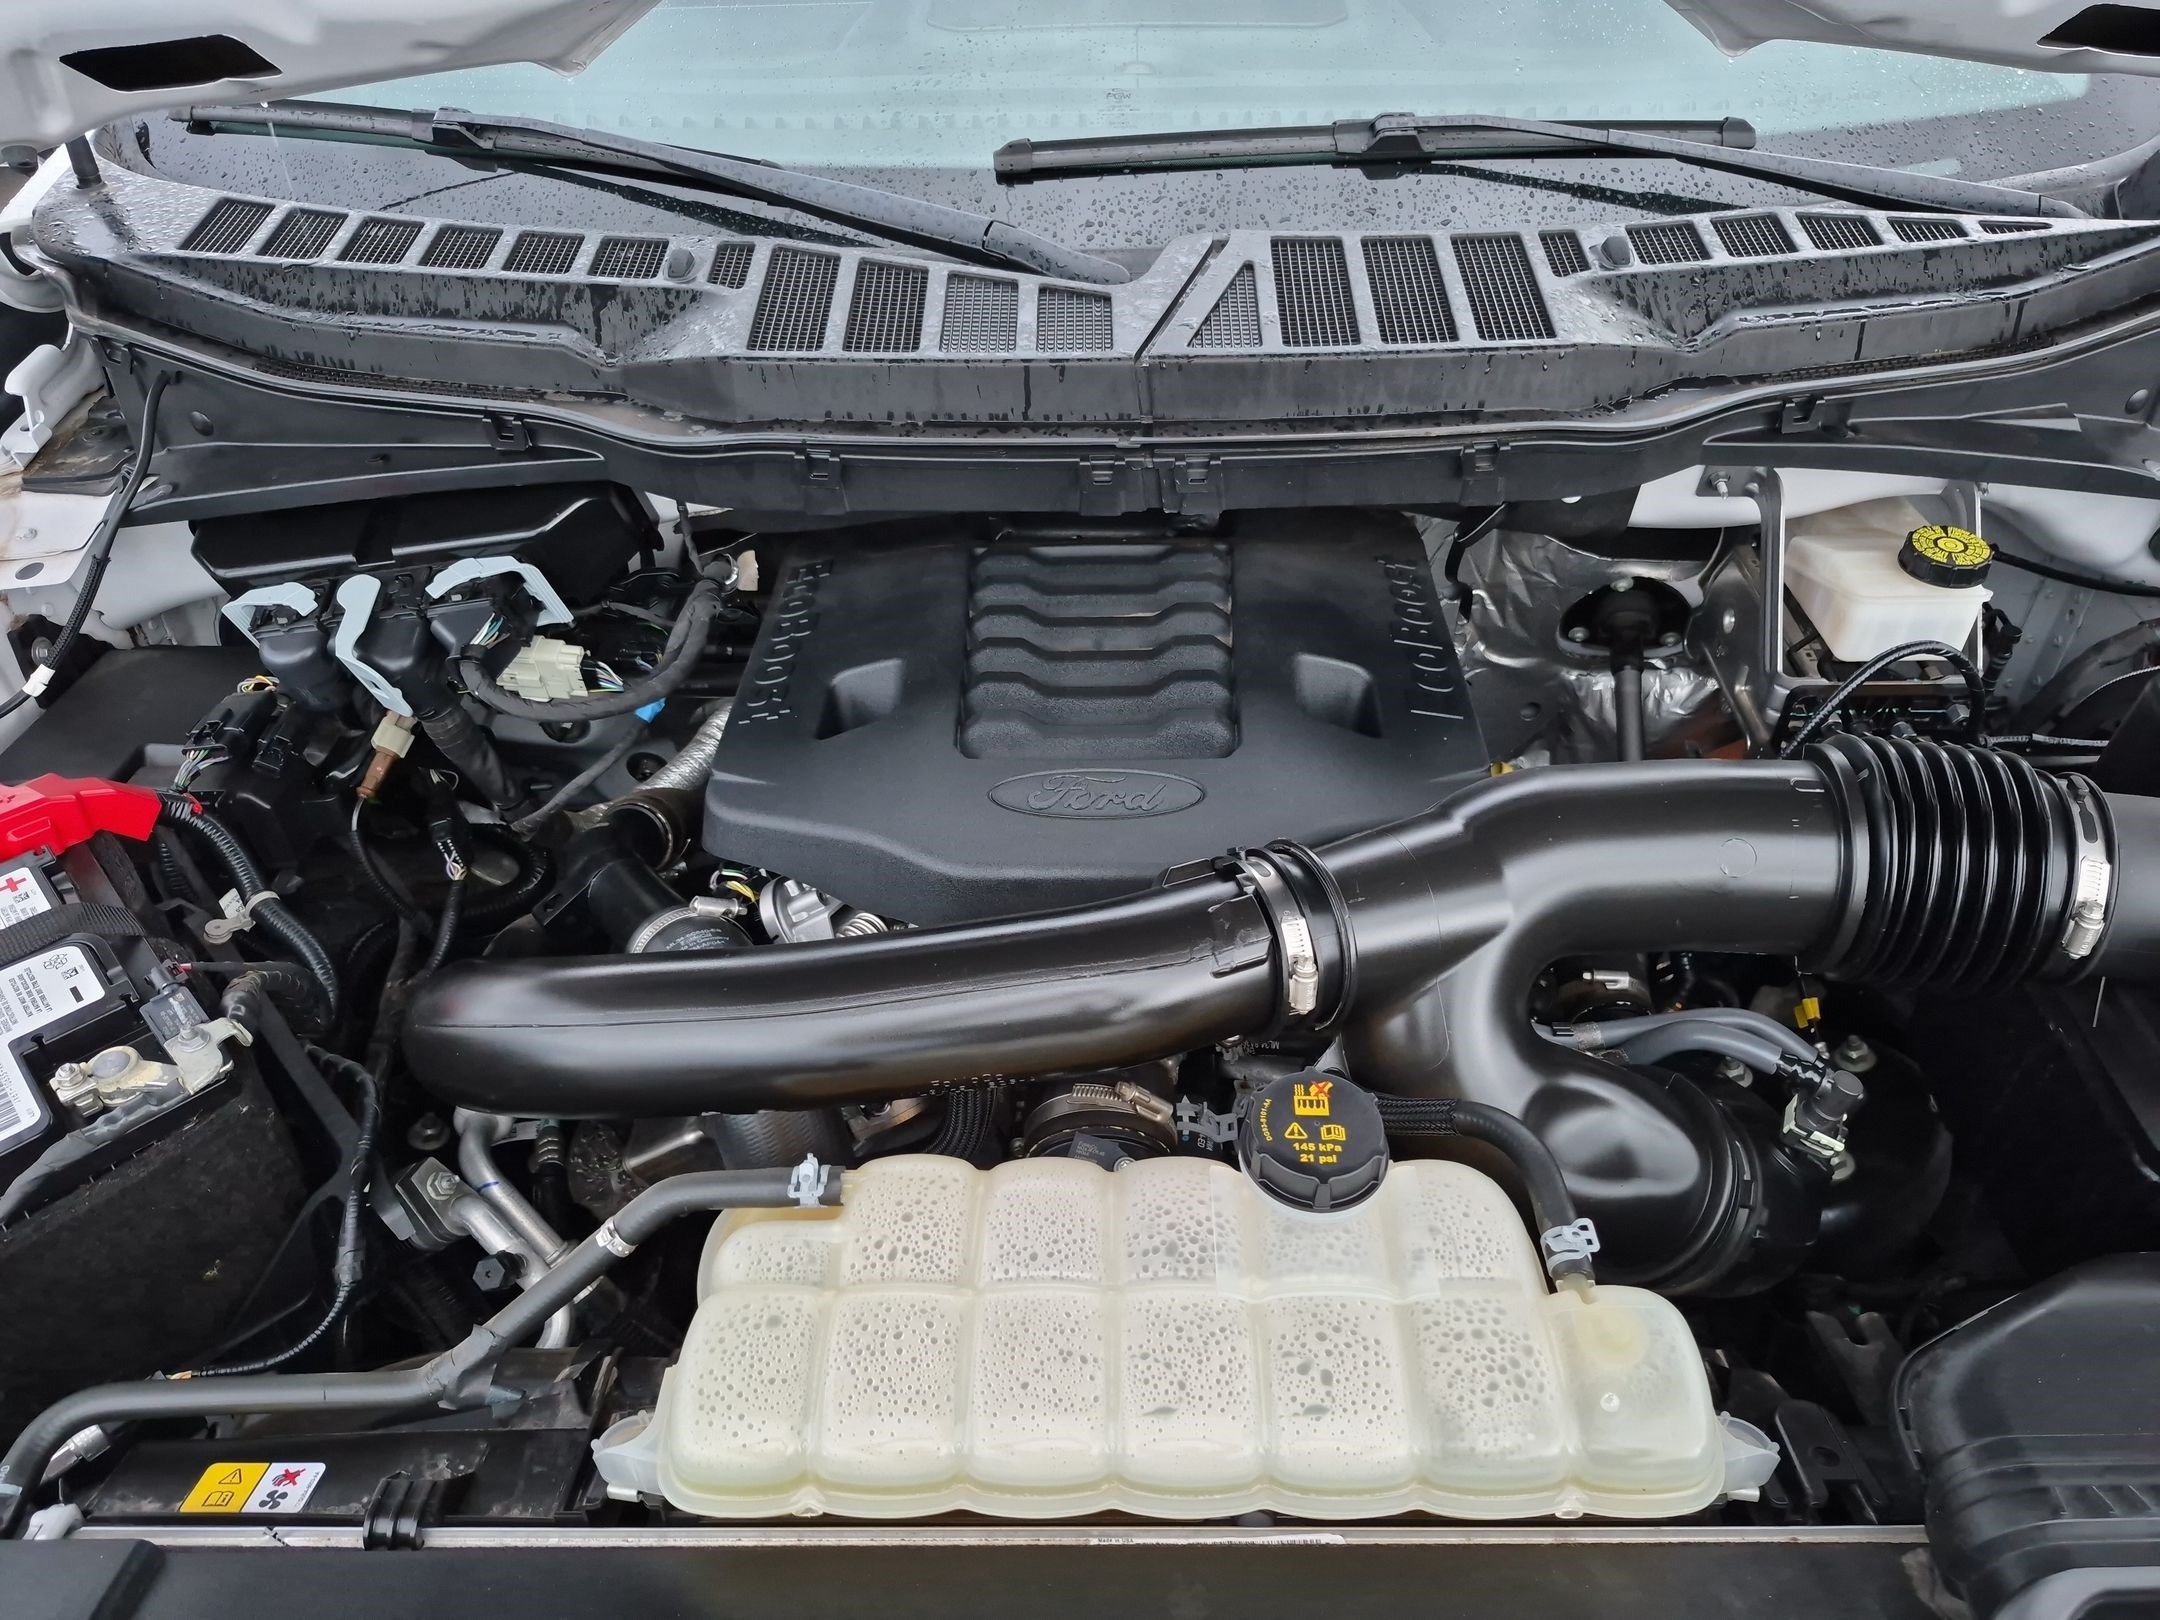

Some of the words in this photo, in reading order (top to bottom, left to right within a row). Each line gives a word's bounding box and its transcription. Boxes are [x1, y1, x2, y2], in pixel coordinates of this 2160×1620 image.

[1028, 774, 1167, 811] Ford
[1293, 1142, 1316, 1151] 145
[1318, 1143, 1342, 1152] kPa
[1300, 1153, 1315, 1162] 21
[1318, 1154, 1337, 1164] psi
